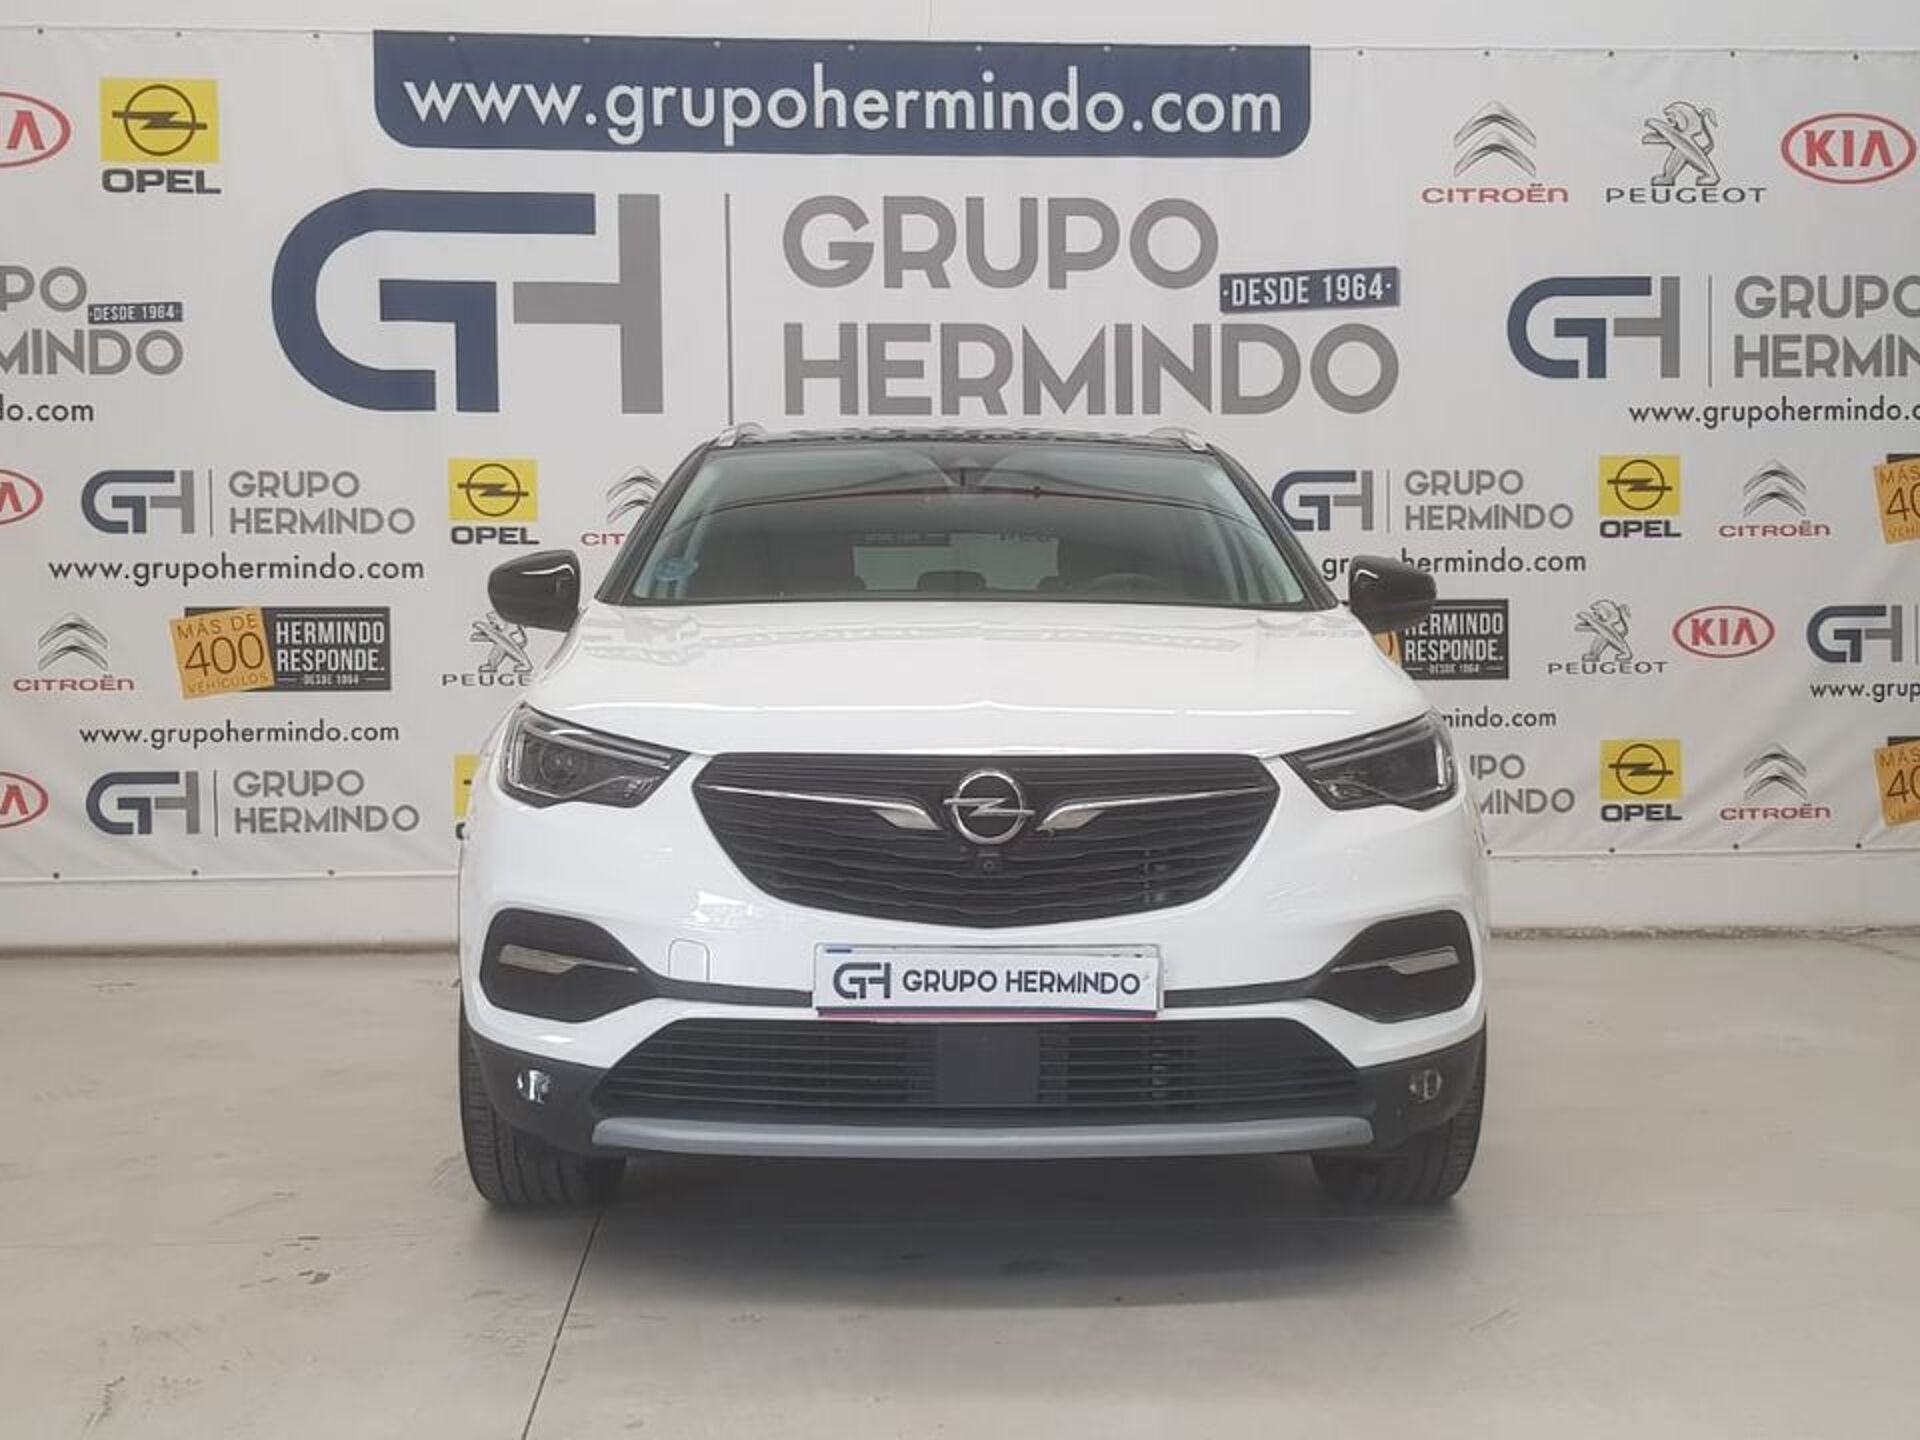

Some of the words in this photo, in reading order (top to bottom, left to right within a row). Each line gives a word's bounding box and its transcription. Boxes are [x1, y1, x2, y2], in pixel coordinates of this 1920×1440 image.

[403, 62, 1281, 147] www.grupohermindo.com
[1804, 130, 1893, 167] KIA
[101, 169, 221, 194] OPEL
[1421, 183, 1568, 204] CITROËN
[1606, 187, 1767, 204] PEUGEOT
[783, 195, 1219, 289] GRUPO
[783, 322, 1400, 416] HERMINDO
[0, 393, 94, 422] o.com
[228, 470, 360, 499] GRUPO
[1404, 469, 1524, 495] GRUPO
[228, 506, 416, 534] HERMINDO
[1404, 503, 1574, 531] HERMINDO
[1600, 520, 1682, 538] OPEL
[1718, 521, 1831, 537] CITROËN
[450, 527, 540, 545] OPEL
[48, 551, 425, 587] www.grupohermindo.com
[275, 620, 386, 645] HERMINDO
[1690, 617, 1758, 646] KIA
[184, 631, 265, 677] 400
[277, 648, 386, 673] RESPONDE.
[1405, 639, 1504, 662] RESPONDE.
[1548, 661, 1668, 675] PEUGEOT
[13, 675, 135, 692] CITROËN
[79, 719, 400, 750] www.grupohermindo.com
[233, 769, 365, 798] GRUPO
[234, 804, 420, 834] HERMINDO
[1600, 804, 1683, 821] OPEL
[1719, 803, 1831, 820] CITROËN
[902, 969, 997, 993] GRUPO
[1006, 970, 1141, 995] HERMINDO
